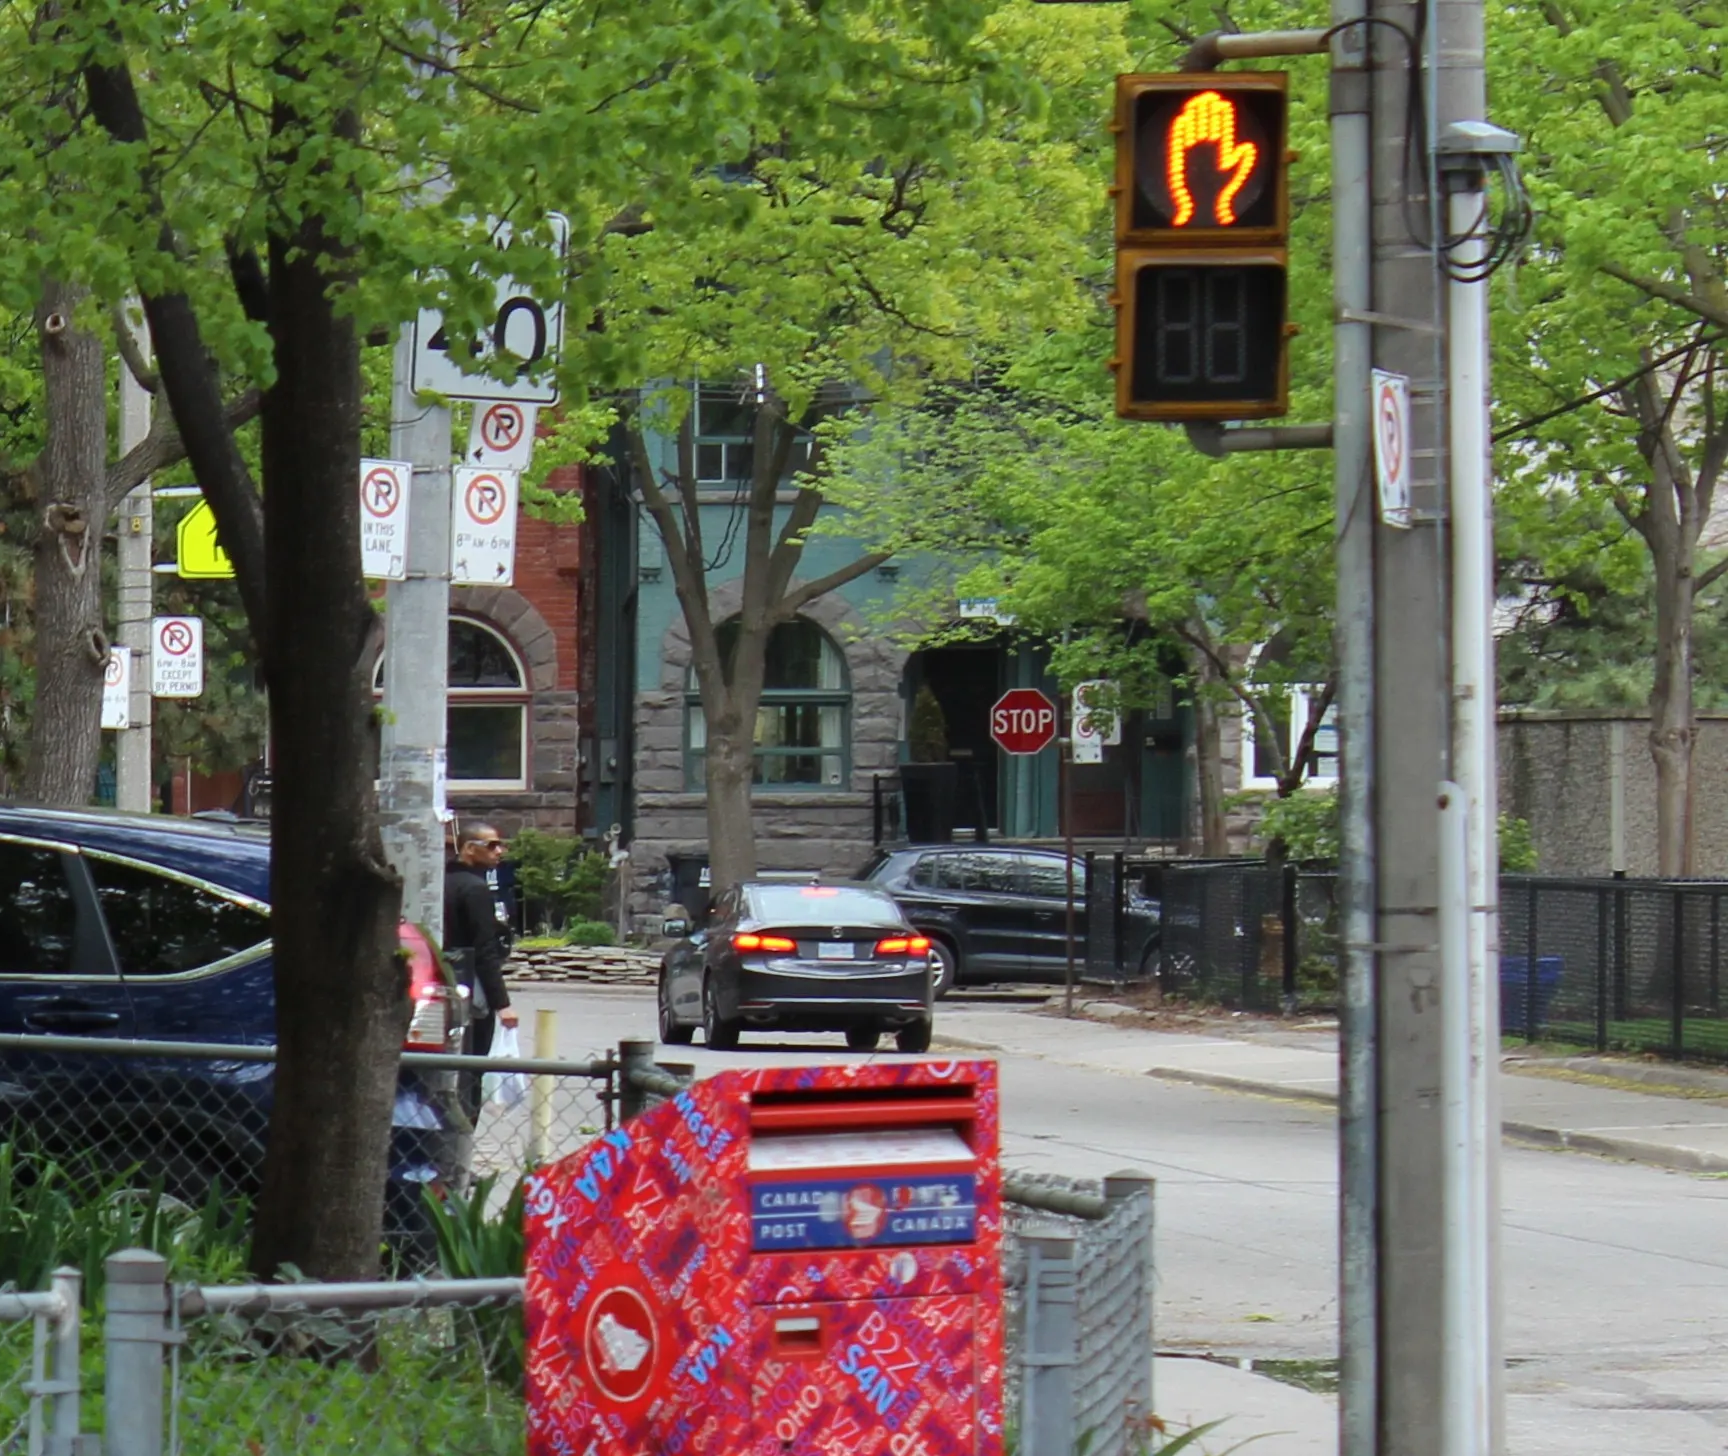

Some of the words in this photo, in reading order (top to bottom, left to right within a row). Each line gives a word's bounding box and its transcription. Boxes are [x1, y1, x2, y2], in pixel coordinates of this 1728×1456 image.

[364, 523, 373, 535] IN
[375, 523, 396, 537] THIS
[365, 540, 392, 554] LANE
[161, 669, 192, 680] EXCEPT
[155, 682, 166, 692] BY
[169, 681, 199, 692] PERMIT
[994, 708, 1053, 734] STOP
[761, 1190, 826, 1208] CANAD
[760, 1222, 808, 1239] POST
[891, 1216, 968, 1233] CANADA
[856, 1311, 921, 1388] B2Z
[838, 1343, 899, 1416] S4N
